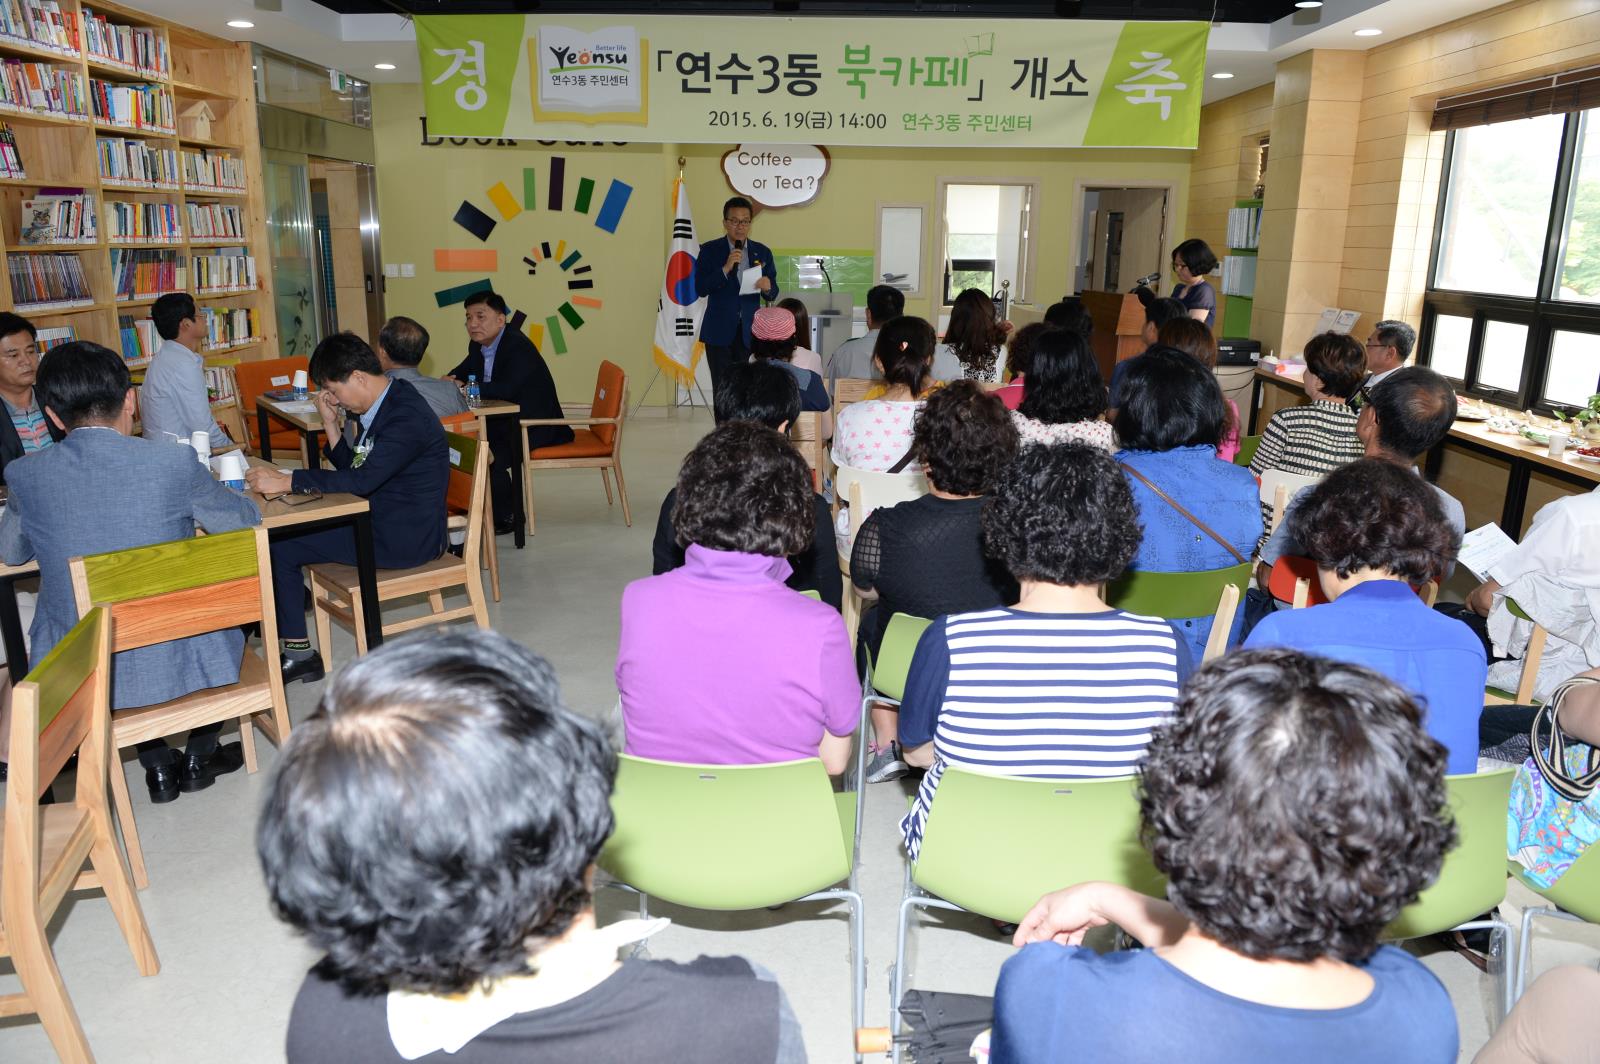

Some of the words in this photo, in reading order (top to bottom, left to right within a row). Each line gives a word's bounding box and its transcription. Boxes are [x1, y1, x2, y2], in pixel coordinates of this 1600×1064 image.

[549, 45, 627, 70] Yeonsu
[431, 39, 488, 111] 경
[551, 75, 588, 87] 연수3동
[590, 75, 628, 87] 주민센터
[1010, 57, 1089, 100] 개소
[1114, 51, 1188, 121] 축
[708, 110, 757, 128] 2015.
[784, 111, 833, 130] 19(금)
[839, 112, 887, 129] 14:00
[902, 113, 962, 132] 연수3동
[966, 114, 1032, 132] 주민센터
[738, 152, 792, 166] Coffee
[752, 178, 767, 189] or
